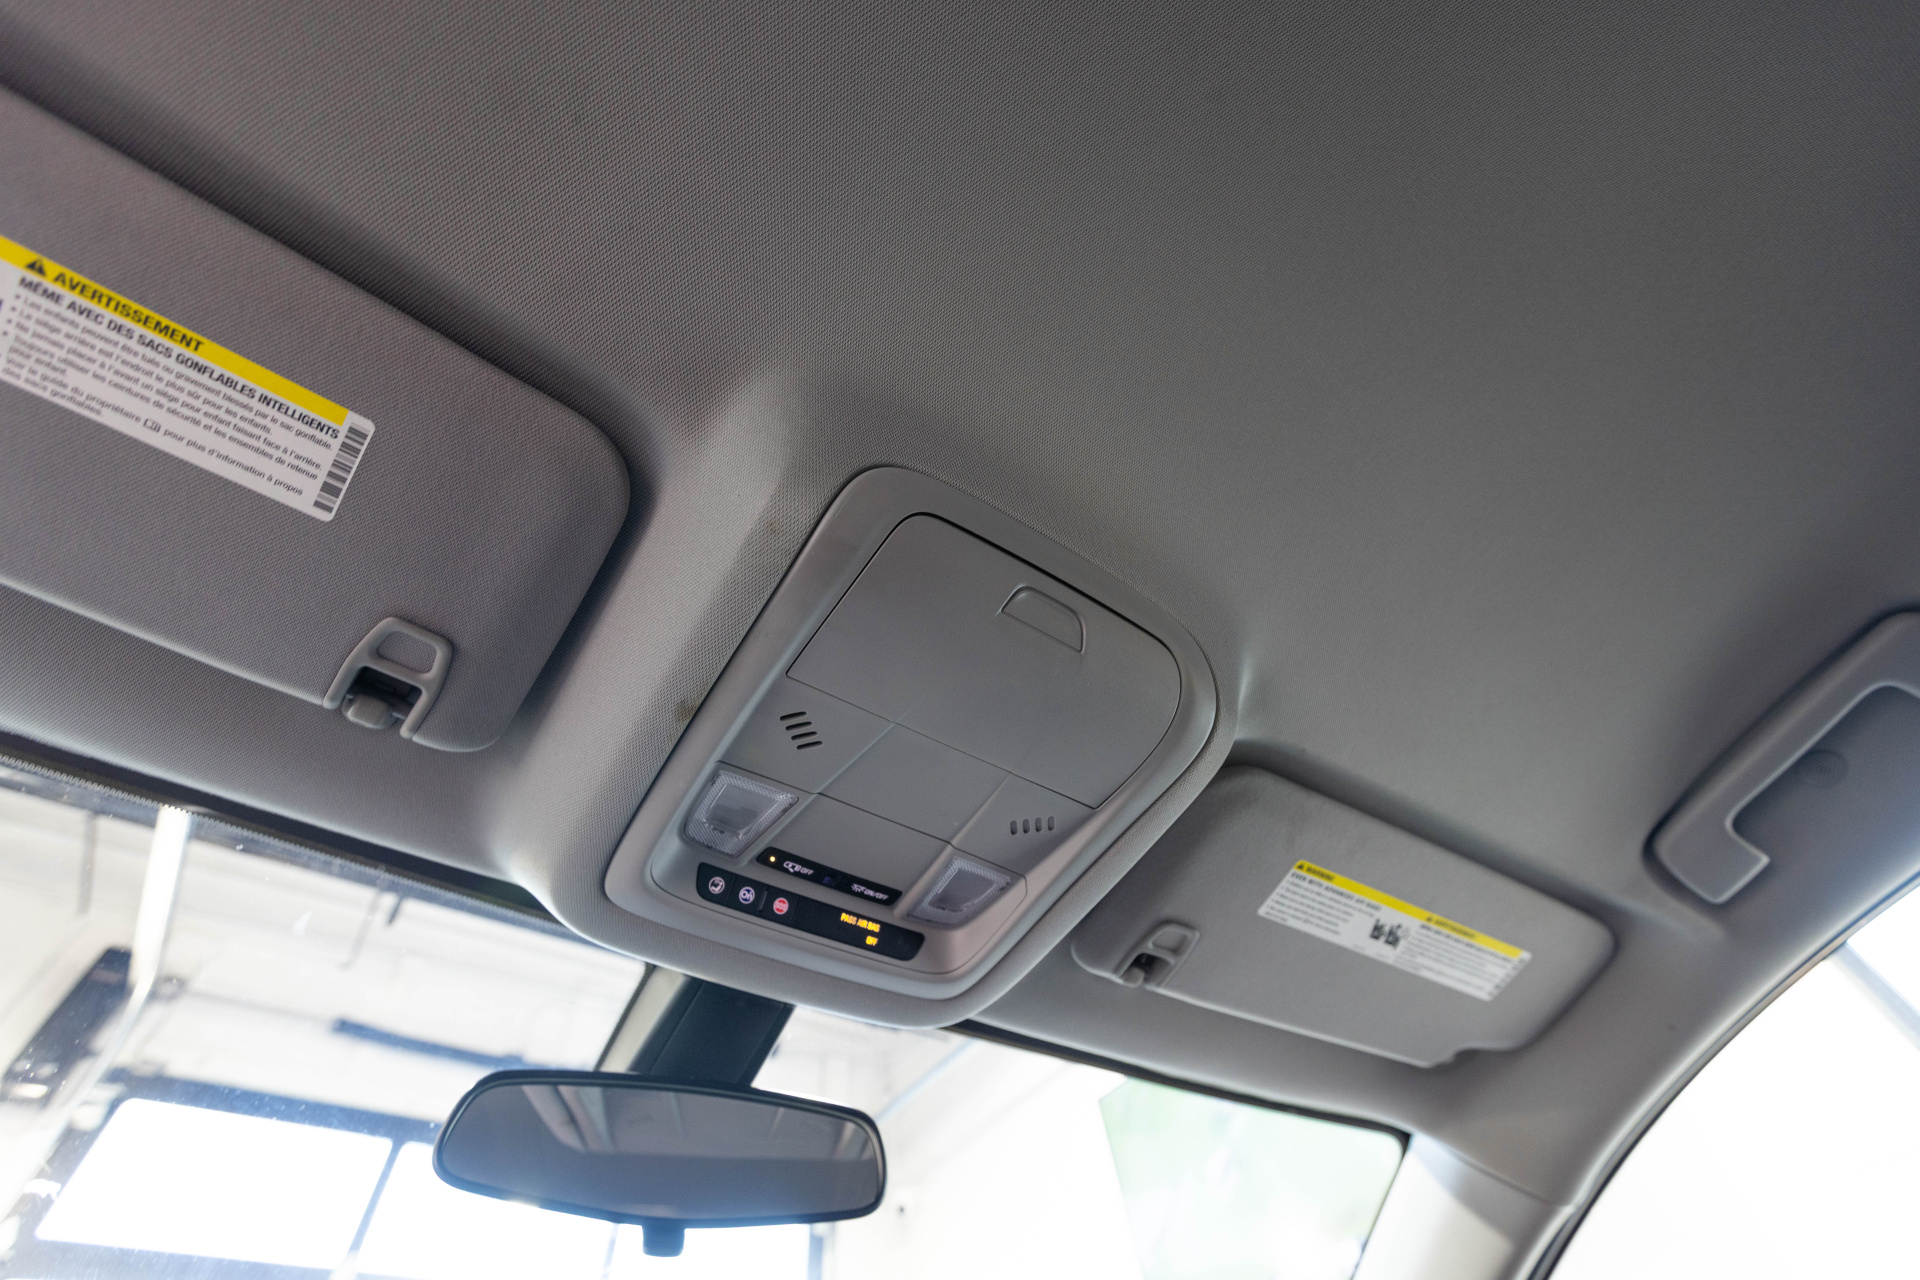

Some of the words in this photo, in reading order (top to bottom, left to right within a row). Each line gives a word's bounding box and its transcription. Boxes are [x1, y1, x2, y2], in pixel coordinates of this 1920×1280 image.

[53, 272, 205, 352] AVERTISSEMENT
[18, 276, 64, 305] MÊME
[66, 300, 105, 326] AVEC
[106, 318, 135, 340] DES
[136, 333, 174, 359] SACS
[175, 352, 257, 400] GONFLABLES
[257, 393, 340, 440] INTELLIGENTS
[63, 331, 97, 351] arrière
[97, 347, 115, 360] est
[114, 354, 155, 379] l'endroit
[164, 379, 186, 395] plus
[186, 389, 202, 401] sûr
[201, 397, 225, 412] pour
[224, 406, 239, 419] les
[66, 347, 98, 366] placer
[107, 364, 141, 386] l'avant
[155, 388, 180, 405] siège
[180, 400, 202, 415] pour
[202, 411, 232, 428] enfant
[232, 423, 262, 442] faisant
[262, 437, 282, 452] face
[80, 325, 120, 350] peuvent
[120, 343, 140, 358] être
[140, 353, 161, 369] tués
[174, 371, 222, 399] gravement
[221, 392, 254, 414] blessés
[253, 409, 270, 421] par
[279, 420, 295, 433] sac
[91, 370, 107, 384] les
[107, 379, 151, 404] ceintures
[165, 406, 202, 427] sécurité
[213, 426, 228, 439] les
[228, 435, 274, 461] ensembles
[286, 462, 318, 481] retenue
[774, 901, 788, 912] SOS
[800, 867, 814, 876] OFF
[840, 912, 857, 925] PASS
[857, 918, 867, 928] AIR
[867, 921, 880, 933] BAG
[866, 935, 878, 946] OFF
